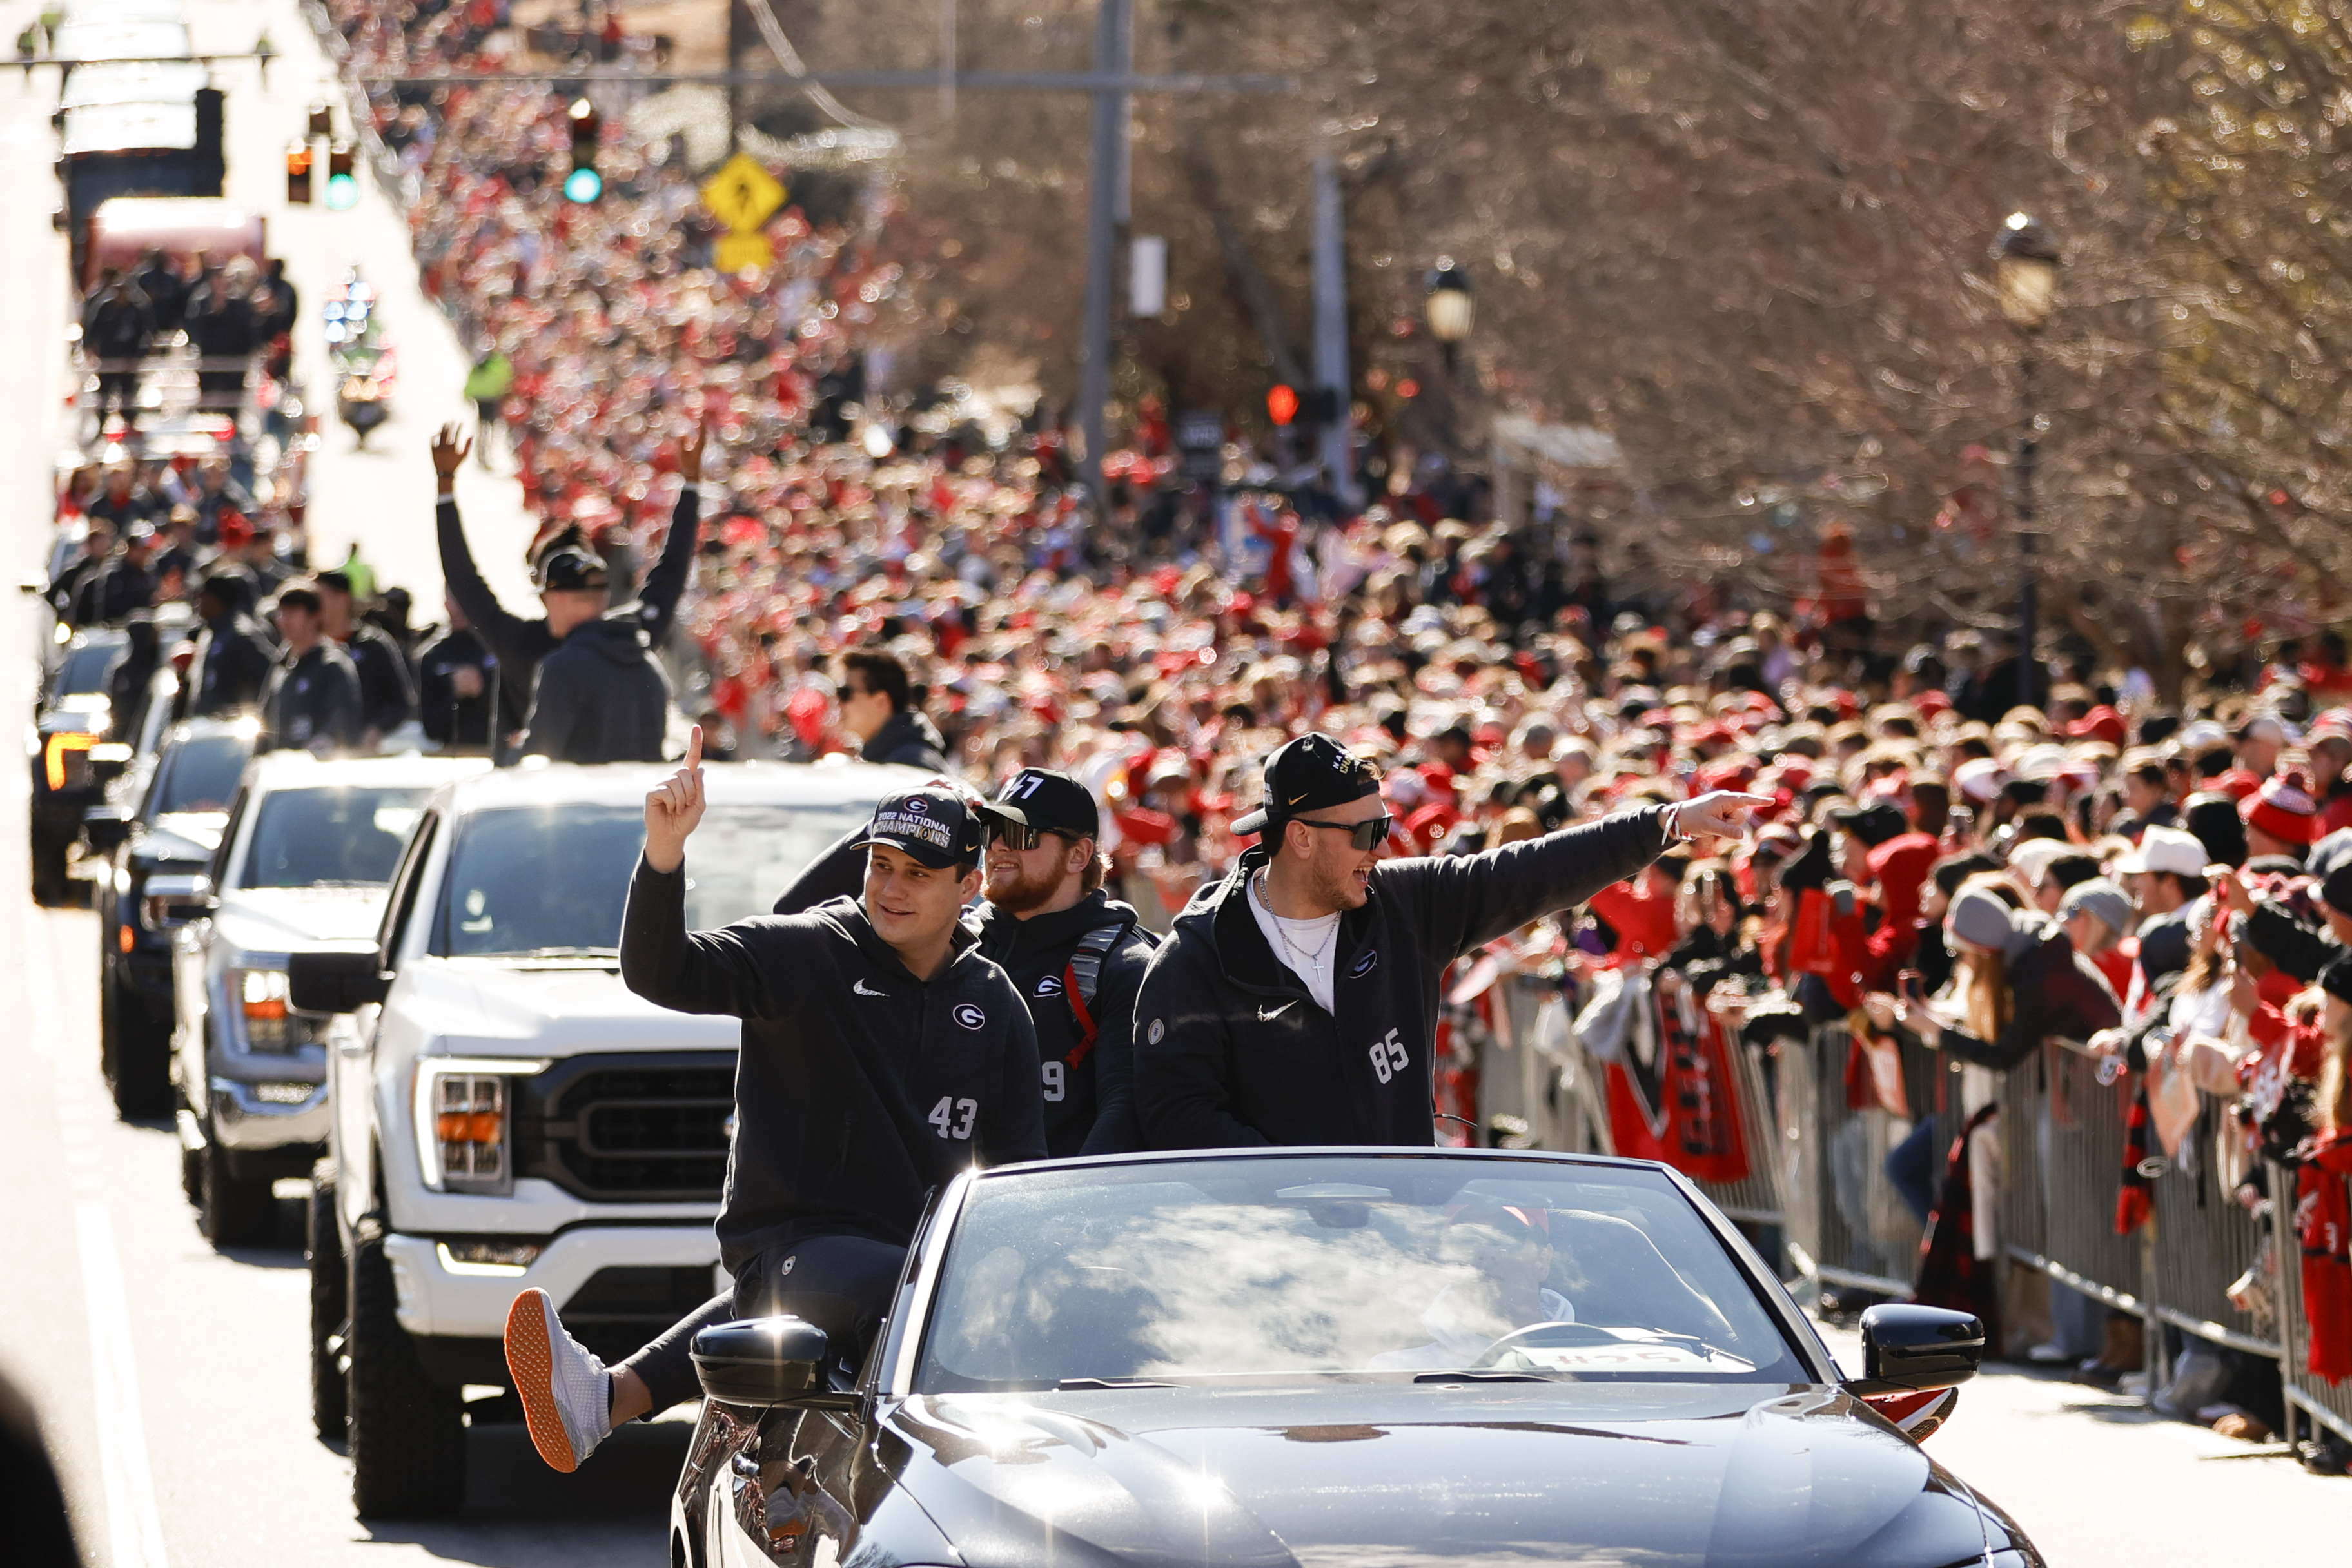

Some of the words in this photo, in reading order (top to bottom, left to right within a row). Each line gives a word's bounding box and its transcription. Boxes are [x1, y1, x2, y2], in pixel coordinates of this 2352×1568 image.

[873, 820, 950, 848] CHAMPIONS
[878, 812, 897, 821] 2022
[898, 812, 951, 836] NATIONAL
[1035, 977, 1062, 995] G
[959, 1006, 985, 1026] G
[1369, 1027, 1409, 1084] 85
[928, 1097, 978, 1139] 43
